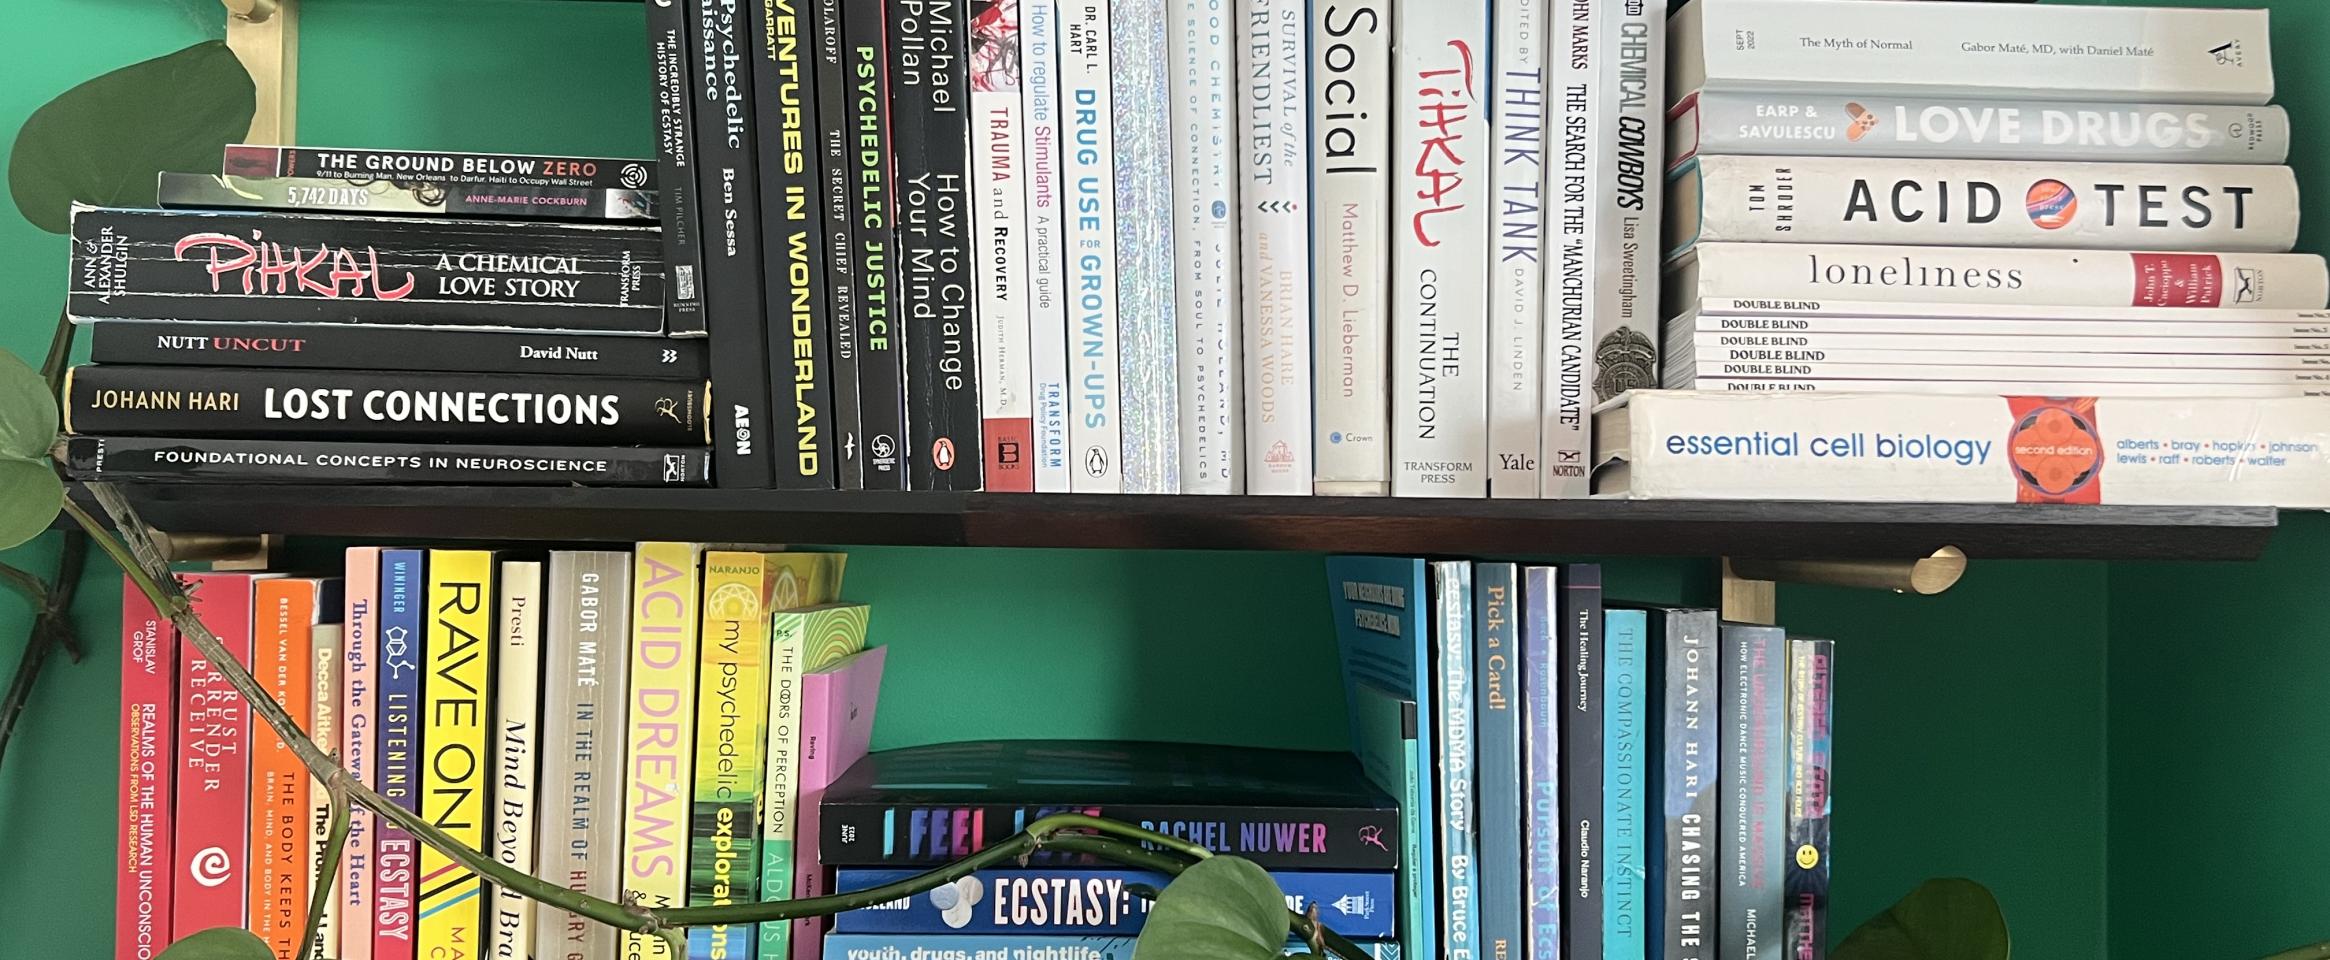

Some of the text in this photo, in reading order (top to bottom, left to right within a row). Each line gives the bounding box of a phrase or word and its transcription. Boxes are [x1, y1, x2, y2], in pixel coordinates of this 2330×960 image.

[900, 0, 924, 85] Pollan
[929, 1, 956, 112] Michael
[1070, 24, 1082, 53] HART
[1572, 26, 1588, 69] MARKS
[1736, 29, 1744, 50] SEPT
[1800, 38, 2153, 56] The Myth of Normal Gabor Maté, MD, with Daniel Maté
[667, 29, 685, 167] THE INCREDIBLY STRANGE
[1325, 5, 1378, 174] Social
[1739, 125, 1835, 139] SAVULESCU
[1895, 106, 2019, 144] LOVE
[2043, 109, 2209, 148] DRUGS
[318, 154, 597, 176] THE GROUND BELOW ZERO
[1502, 68, 1540, 262] THINK TANK
[1617, 24, 1648, 318] CHEMICAL COWBOYS Lisa Sweetingham
[722, 168, 737, 256] Ben Sessa
[857, 47, 887, 350] PSYCHEDELIC JUSTICE
[1750, 185, 1764, 211] TOM
[1776, 168, 1792, 231] SHRODER
[1843, 179, 2253, 229] ACID TEST
[676, 207, 685, 245] PILCHER
[909, 172, 936, 318] Your Mind
[84, 240, 97, 288] ANN &
[99, 226, 113, 304] ALEXANDER
[114, 235, 128, 296] SHULGIN
[937, 175, 964, 390] How to Change
[1075, 90, 1106, 429] DRUG USE FOR GROWN-UPS
[439, 277, 580, 297] LOVE STORY
[1734, 300, 1820, 310] DOUBLE BLIND
[158, 336, 305, 352] NUTT UNCUT
[787, 187, 818, 475] IN WONDERLAND
[1280, 271, 1293, 385] BRIAN HARE
[1721, 336, 1807, 346] DOUBLE BLIND
[1722, 319, 1808, 330] DOUBLE BLIND
[520, 346, 598, 360] David Nutt
[1419, 269, 1436, 439] CONTINUATION
[1443, 332, 1459, 377] THE
[1725, 364, 1811, 375] DOUBLE BLIND
[1730, 350, 1825, 361] DOUBLE BLIND
[92, 388, 619, 424] JOHANN HARI LOST CONNECTIONS
[1049, 383, 1061, 467] TRANSFORM
[155, 451, 606, 471] FOUNDATIONAL CONCEPTS IN NEUROSCIENCE
[1404, 462, 1472, 471] TRANSFORM
[1499, 455, 1535, 470] Yale
[1667, 432, 1991, 465] essential cell biology
[2117, 453, 2286, 466] lewis raff roberts walter
[1421, 475, 1455, 483] PRESS
[393, 562, 406, 613] WININGER
[709, 566, 760, 574] NARANJO
[133, 631, 143, 663] GROF
[145, 620, 156, 674] STANISLAV
[511, 597, 525, 646] Presti
[348, 599, 367, 707] Through the
[1488, 586, 1506, 710] Pick a Card!
[1577, 609, 1589, 712] The Healing Journey
[318, 648, 332, 700] Decca
[189, 660, 206, 767] RECEIVE
[433, 582, 480, 829] RAVE ON
[571, 574, 599, 860] GABOR MATÉ IN THE REALM OF
[631, 557, 684, 878] ACID DREAMS
[773, 647, 793, 833] THE DOORS OF PERCEPTION
[808, 736, 816, 759] Raving
[128, 704, 139, 872] OBSERVATIONS FROM LSD RESEARCH
[1615, 629, 1633, 937] THE COMPASSIONATE INSTINCT
[1681, 635, 1701, 947] JOHANN HARI CHASING THE
[316, 804, 329, 835] The
[379, 694, 410, 940] LISTENING ECSTASY
[1240, 822, 1328, 853] NUWER
[280, 773, 294, 928] THE BODY KEEPS
[350, 820, 364, 905] the Heart
[1579, 820, 1590, 898] Claudio Naranjo
[994, 878, 1128, 926] ECSTASY:
